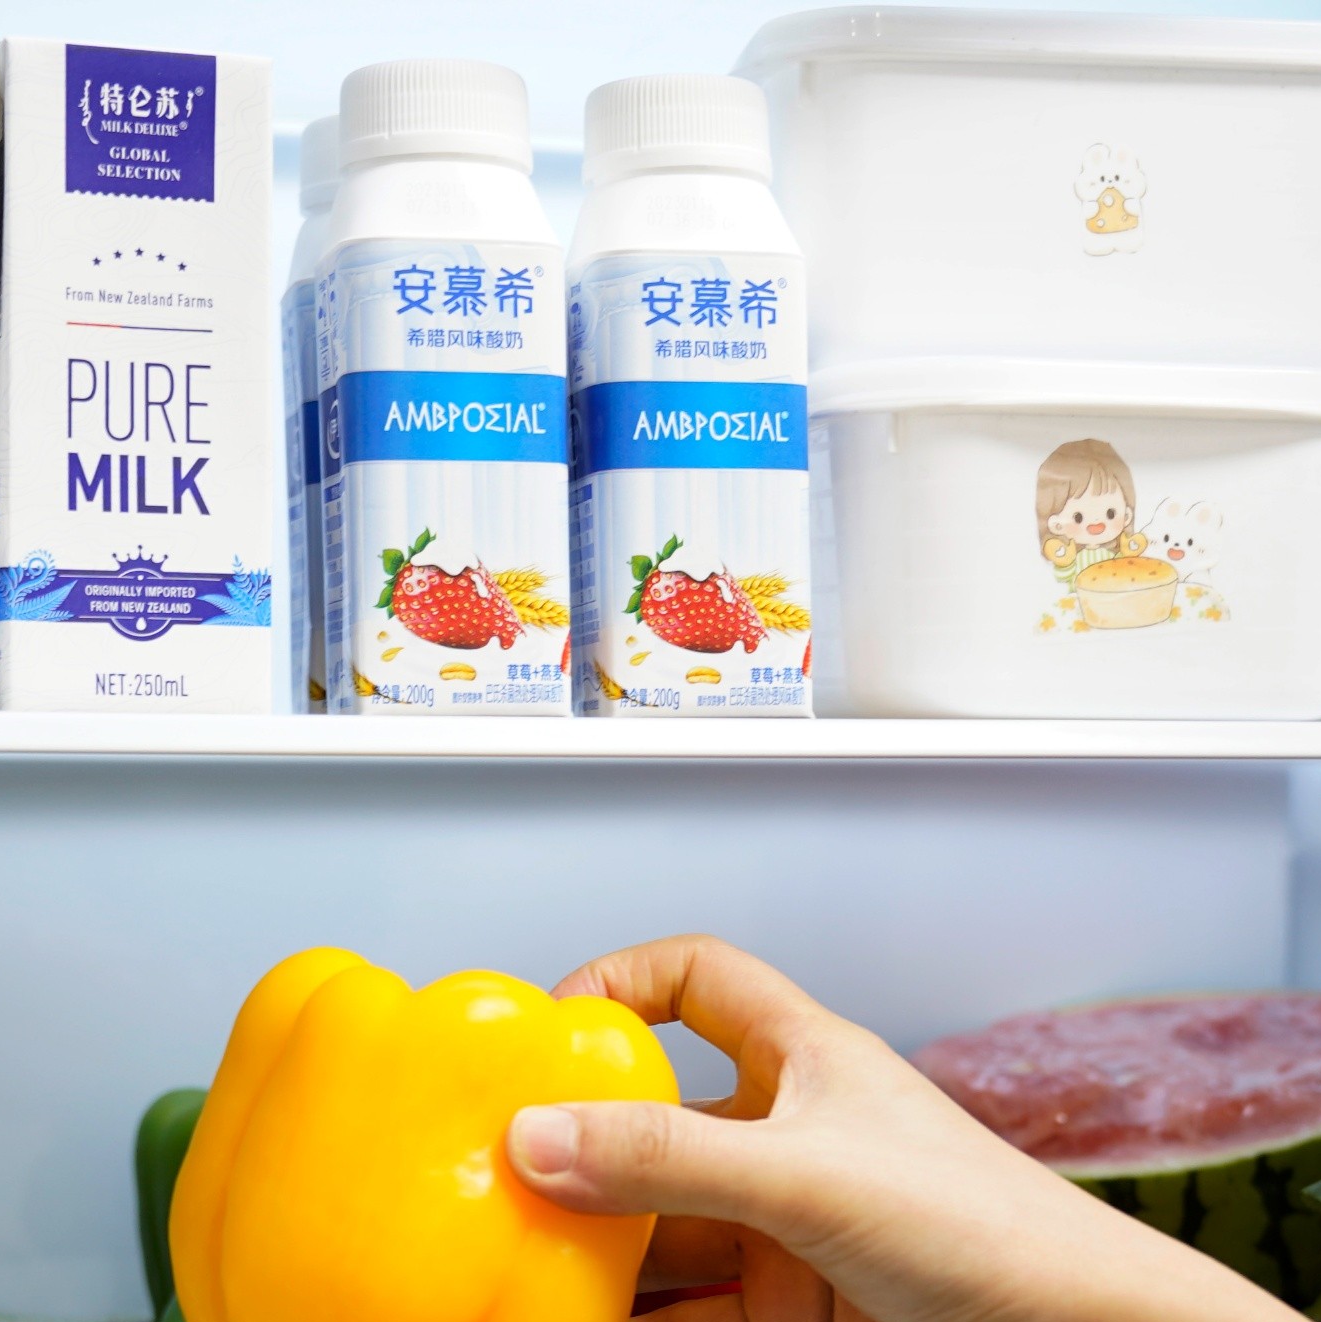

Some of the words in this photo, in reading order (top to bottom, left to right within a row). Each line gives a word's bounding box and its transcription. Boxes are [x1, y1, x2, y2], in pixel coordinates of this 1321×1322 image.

[100, 82, 179, 120] 特仑苏
[100, 120, 132, 134] MILK
[134, 122, 179, 137] DELUXE
[109, 146, 171, 163] GLOBAL
[97, 164, 181, 182] SELECTION
[66, 287, 94, 302] From
[99, 289, 123, 304] New
[127, 291, 173, 307] Zealand
[178, 293, 214, 309] Farms
[393, 264, 534, 318] 安慕希
[641, 276, 778, 329] 安慕希
[407, 328, 524, 350] 希腊风味酸奶
[655, 339, 767, 361] 希腊风味酸奶
[67, 358, 211, 445] PURE
[67, 452, 211, 516] MILK
[85, 585, 142, 597] ORIGINALLY
[145, 586, 196, 599] IMPORTED
[90, 601, 120, 613] FROM
[122, 602, 145, 613] NEW
[147, 602, 192, 614] ZEALAND
[507, 663, 563, 682] 草莓+燕麦
[750, 667, 804, 685] 草莓+燕麦
[95, 673, 188, 698] NET:250mL
